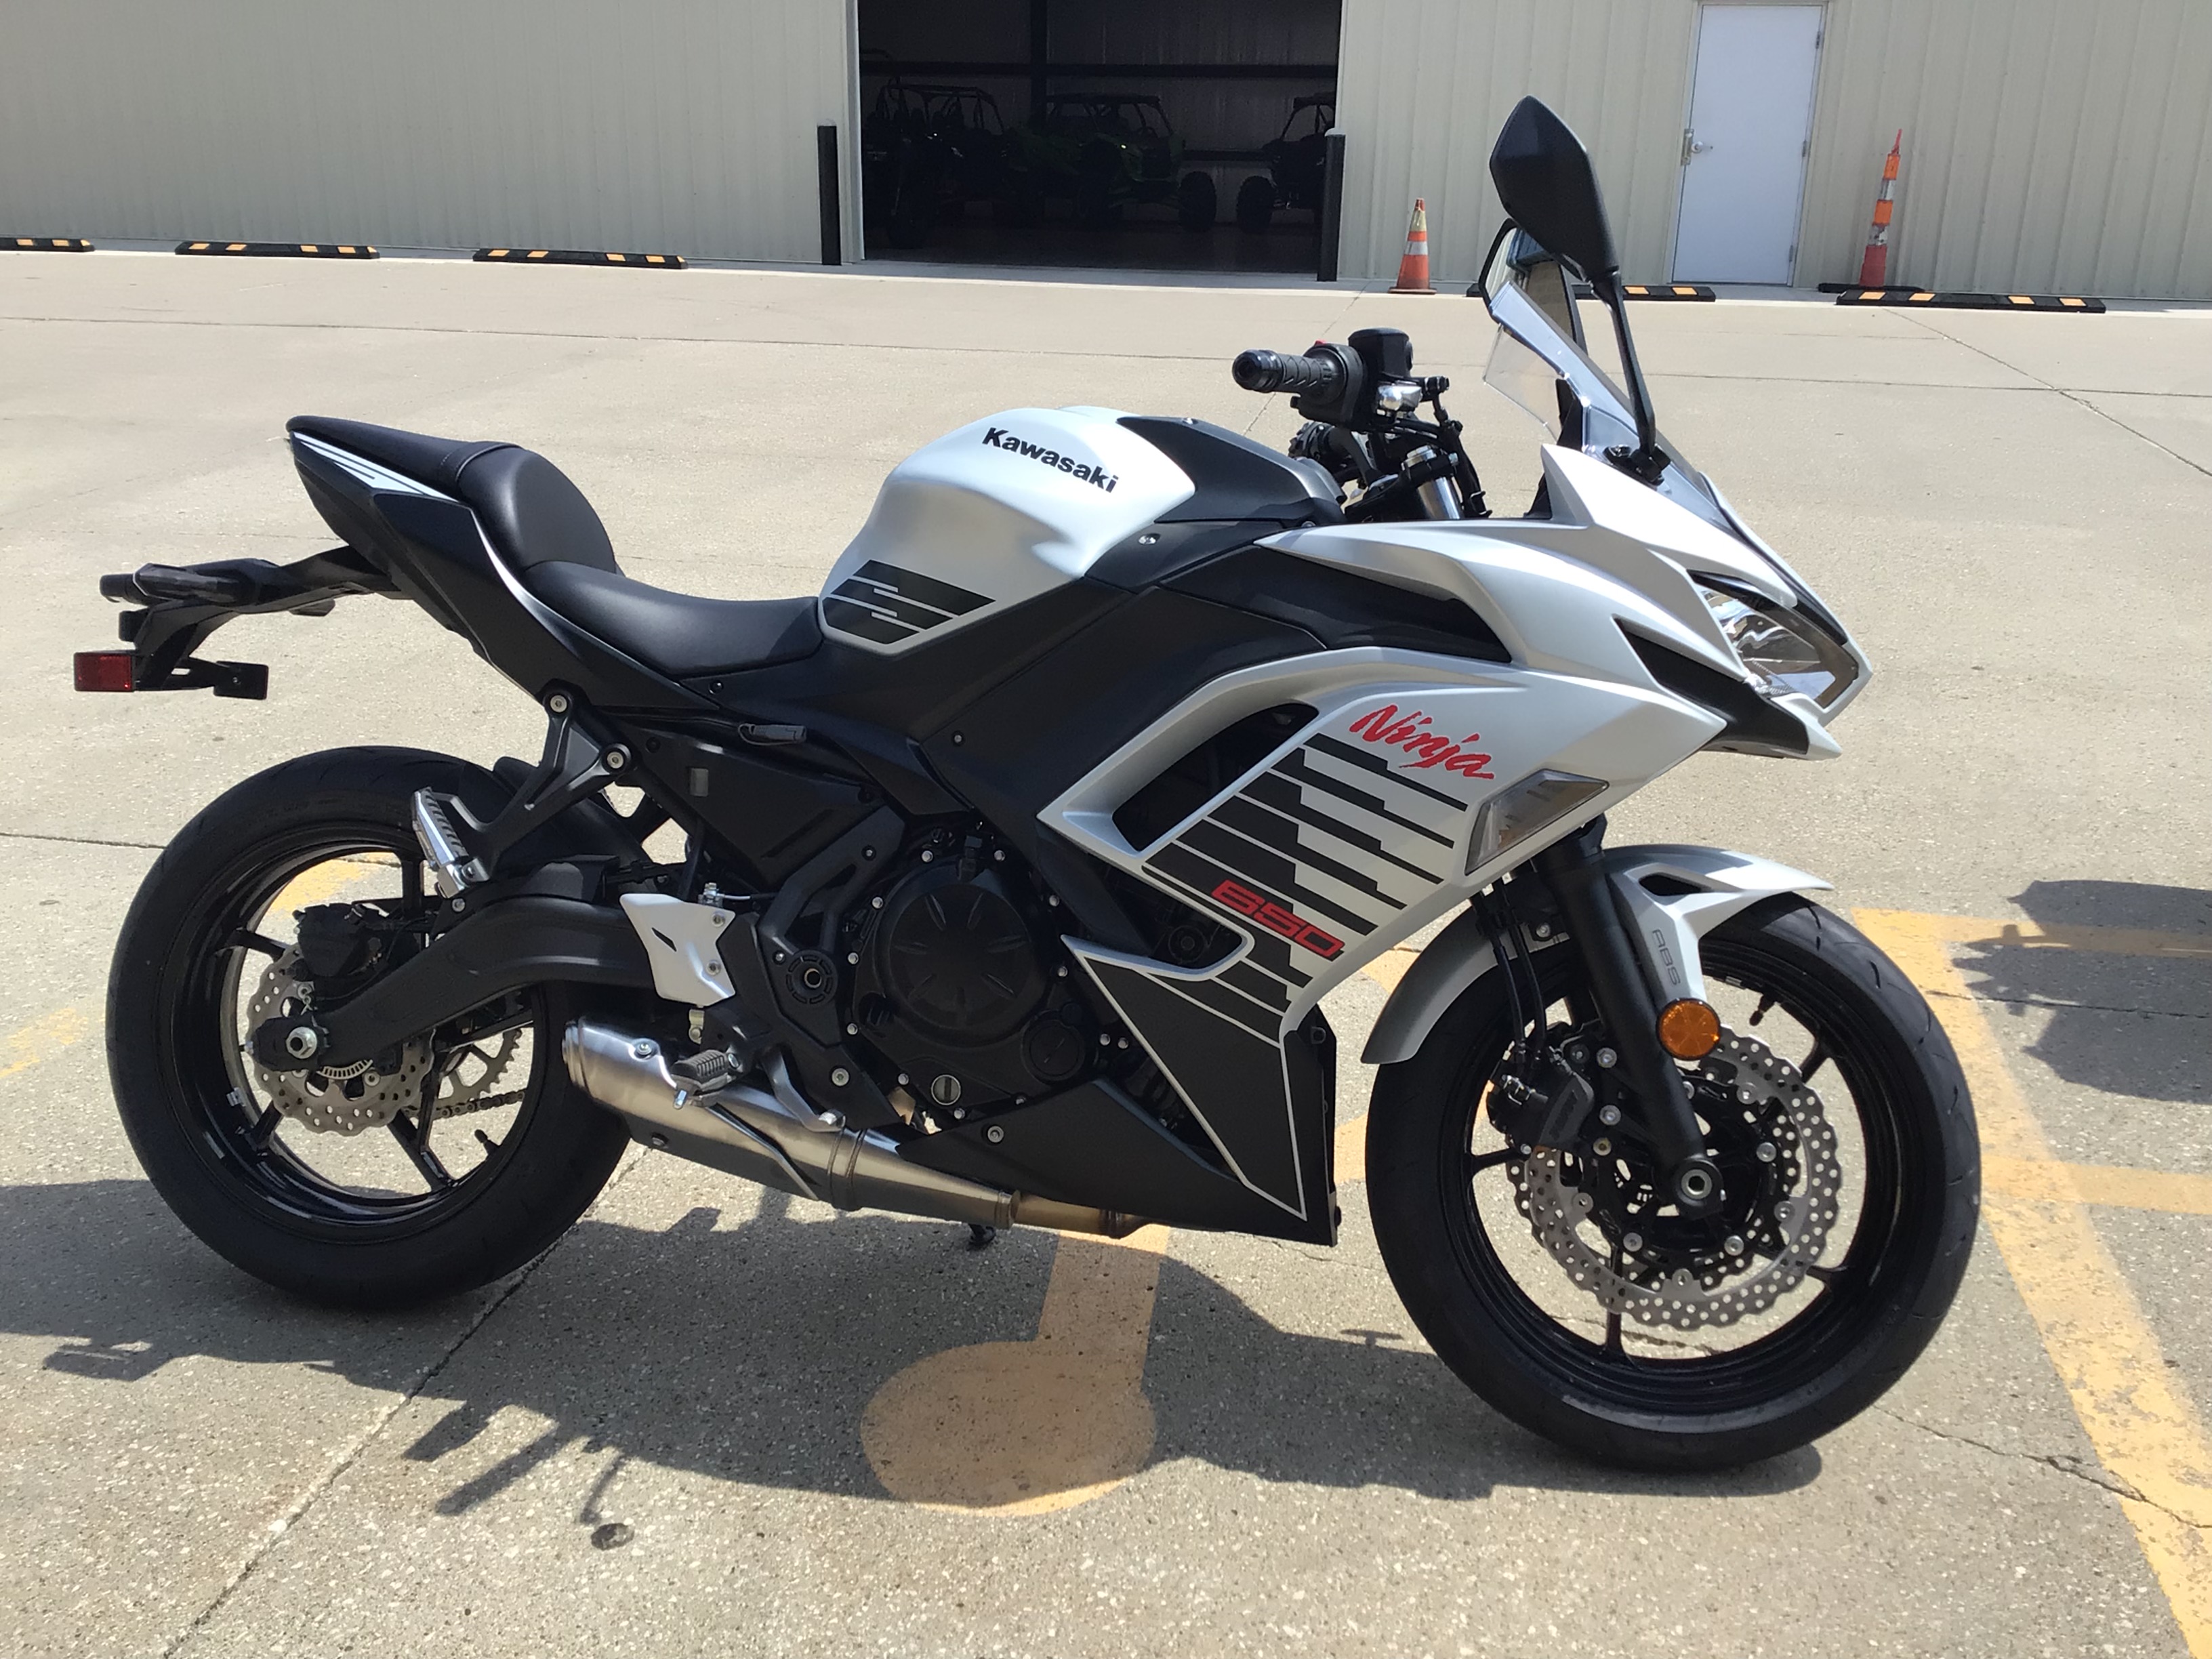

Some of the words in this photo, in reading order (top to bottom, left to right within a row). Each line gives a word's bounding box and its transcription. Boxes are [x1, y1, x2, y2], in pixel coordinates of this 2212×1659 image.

[982, 427, 1118, 493] Kawasaki
[1349, 703, 1495, 779] Ninja
[1211, 880, 1345, 957] 650
[1652, 928, 1681, 985] ABS
